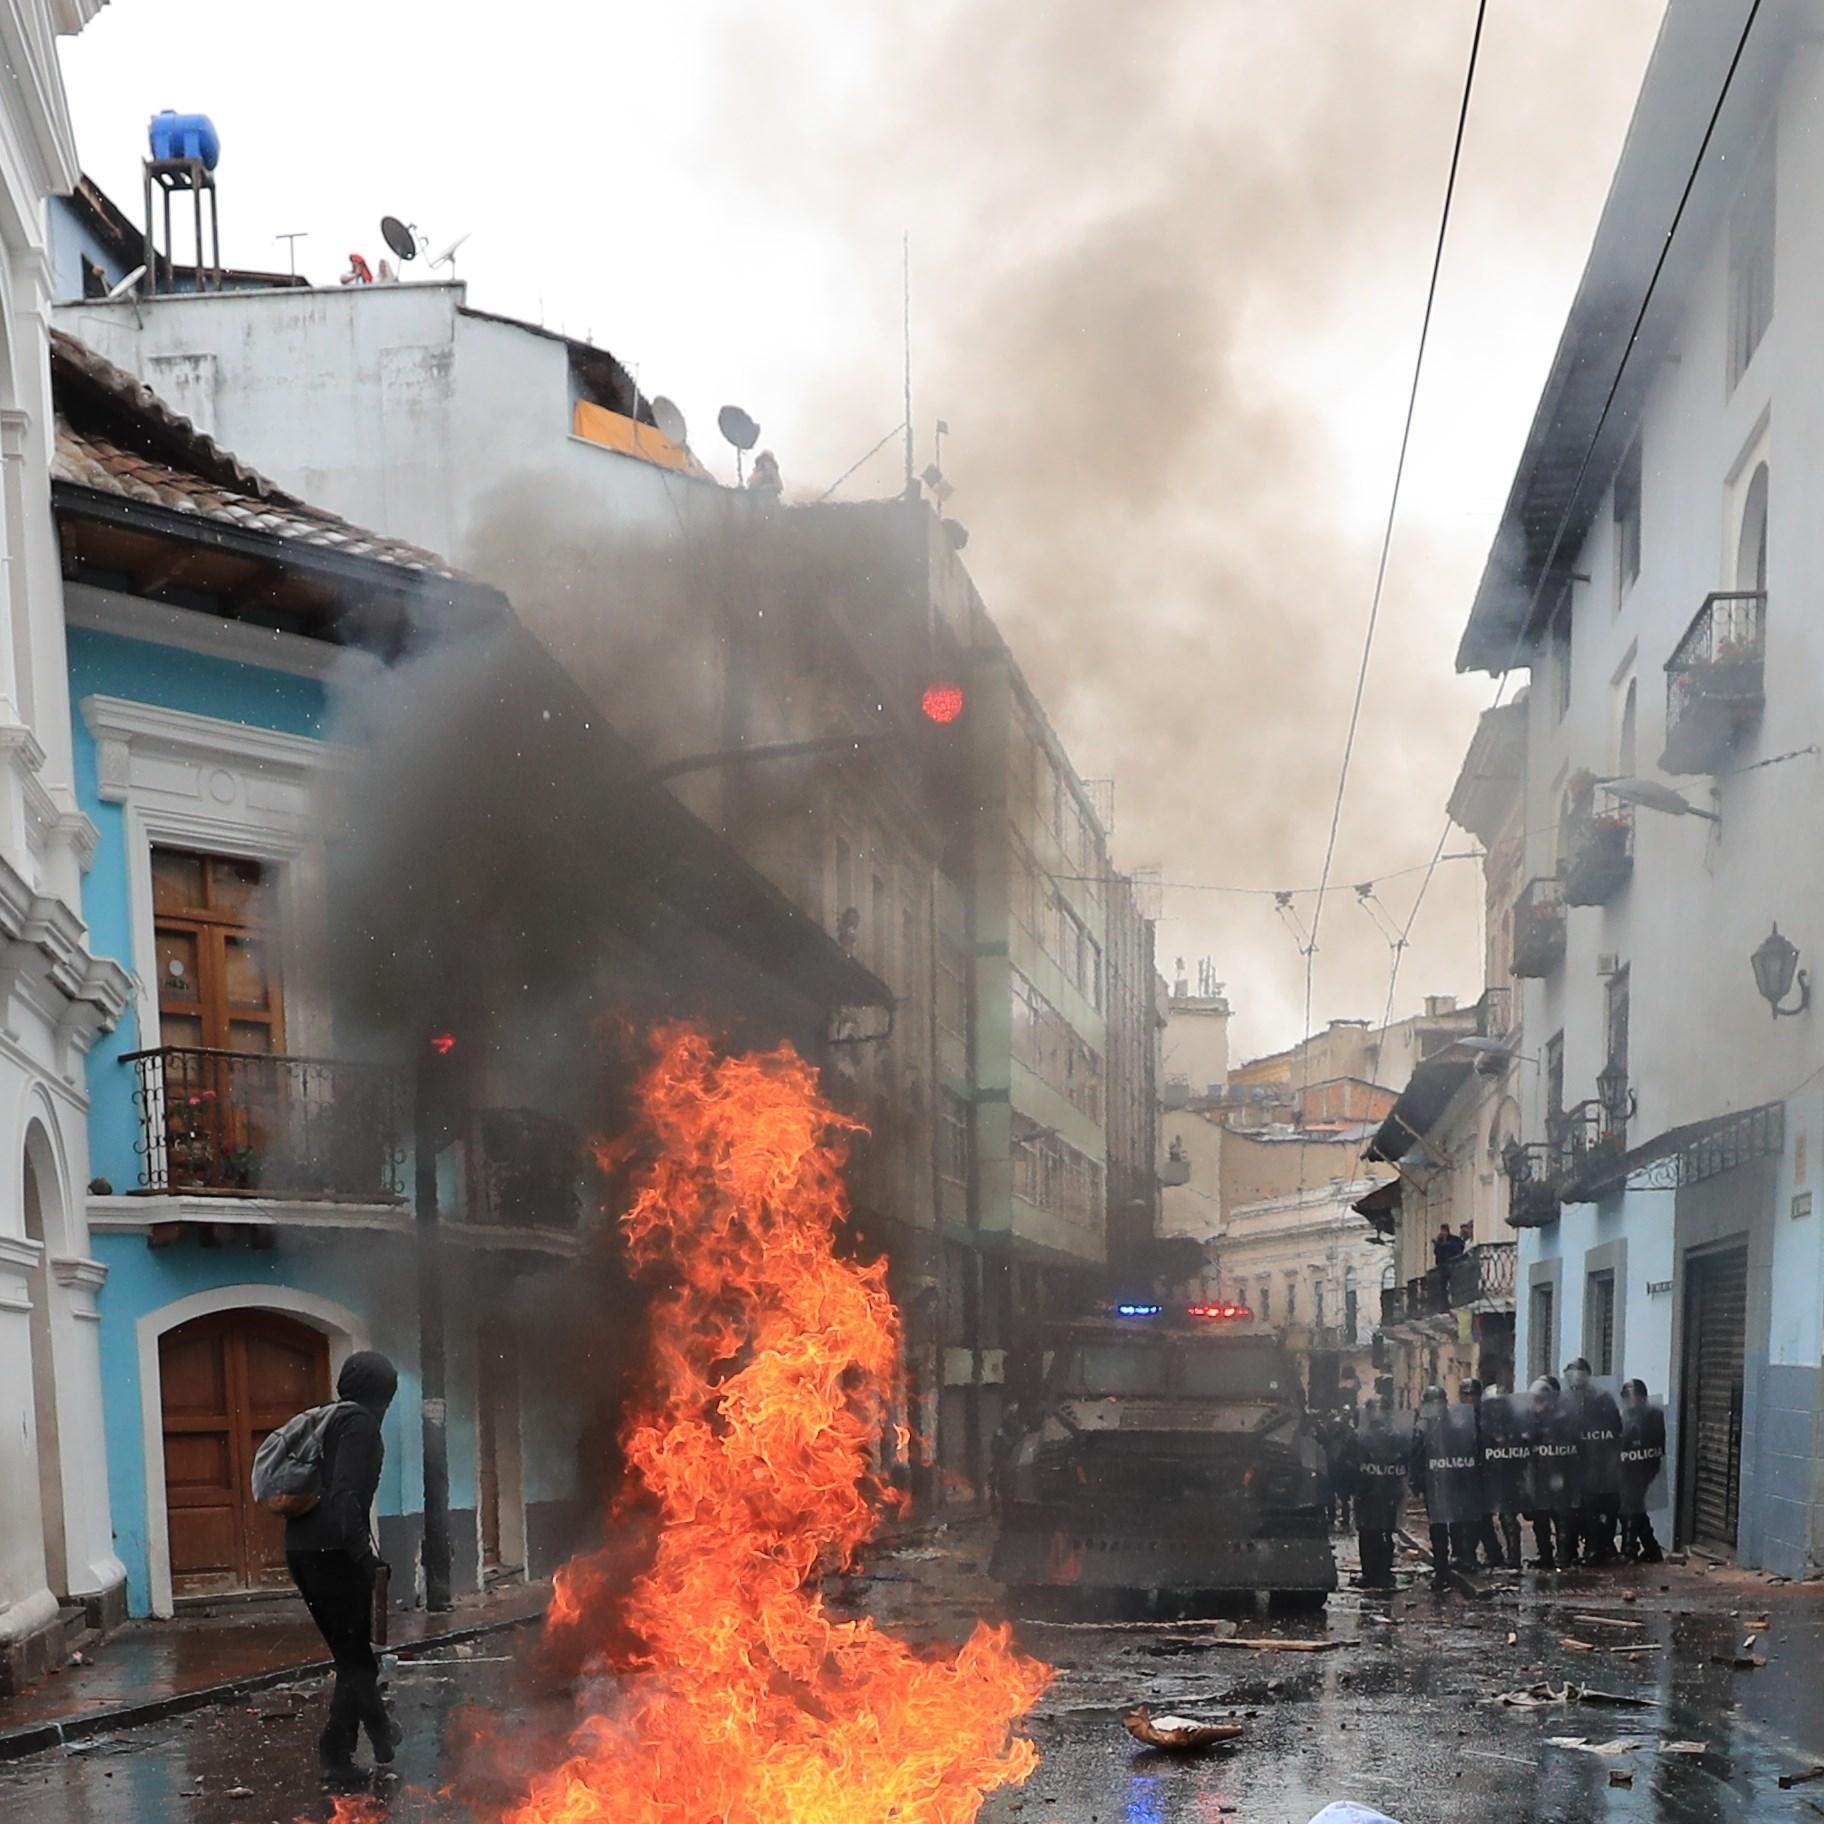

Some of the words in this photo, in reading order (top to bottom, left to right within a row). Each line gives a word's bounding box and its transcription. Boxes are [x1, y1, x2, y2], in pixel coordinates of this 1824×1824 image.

[1580, 1429, 1614, 1441] LICIA
[1484, 1446, 1531, 1461] POLICIA
[1619, 1446, 1663, 1463] POLICIA
[1428, 1456, 1475, 1470] POLICIA
